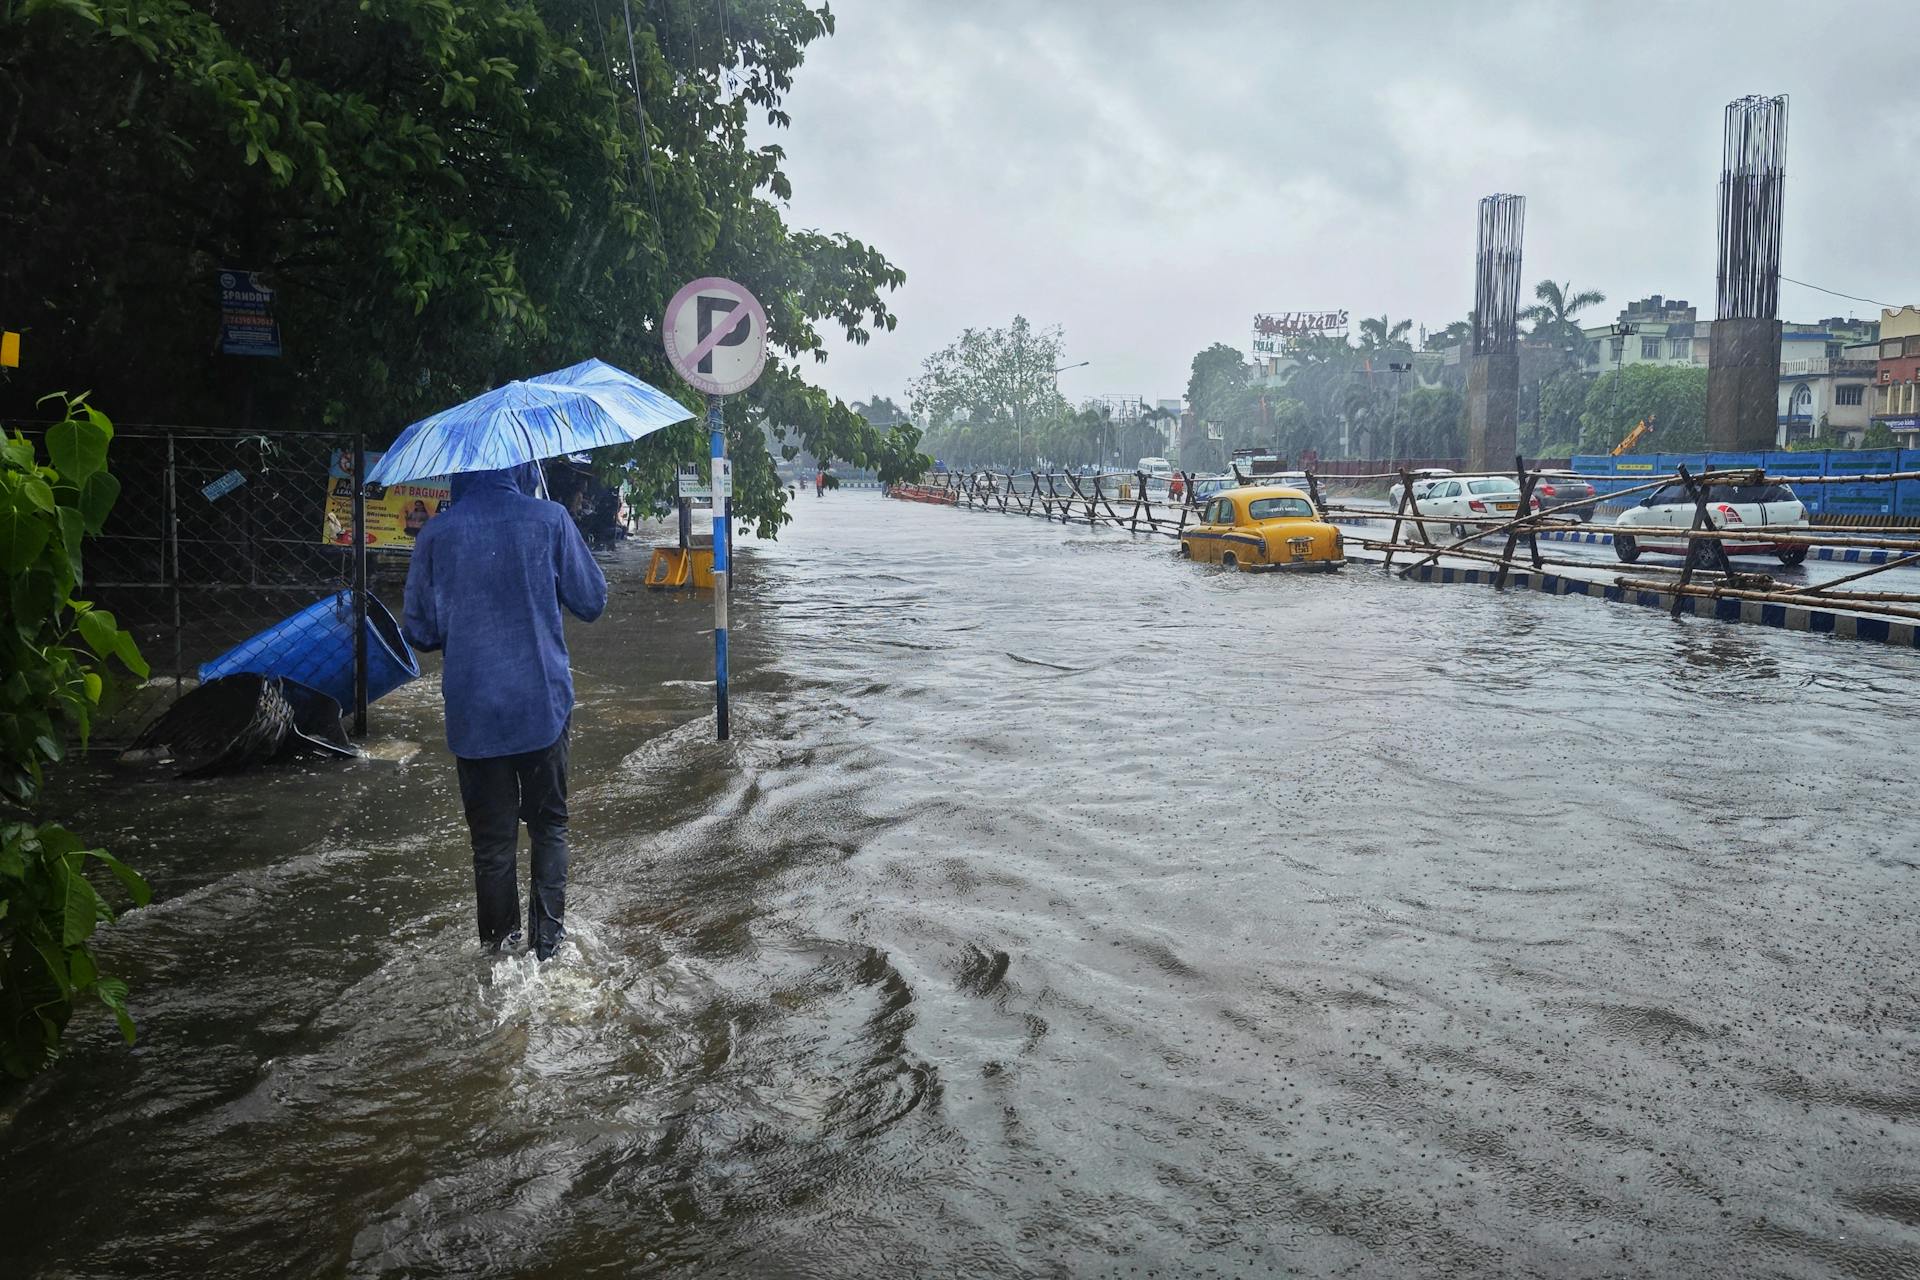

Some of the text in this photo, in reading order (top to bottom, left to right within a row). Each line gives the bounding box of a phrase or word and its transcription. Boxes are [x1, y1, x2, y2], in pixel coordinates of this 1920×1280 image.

[223, 289, 270, 302] SPANDAN
[697, 295, 751, 374] P
[393, 486, 406, 496] AT
